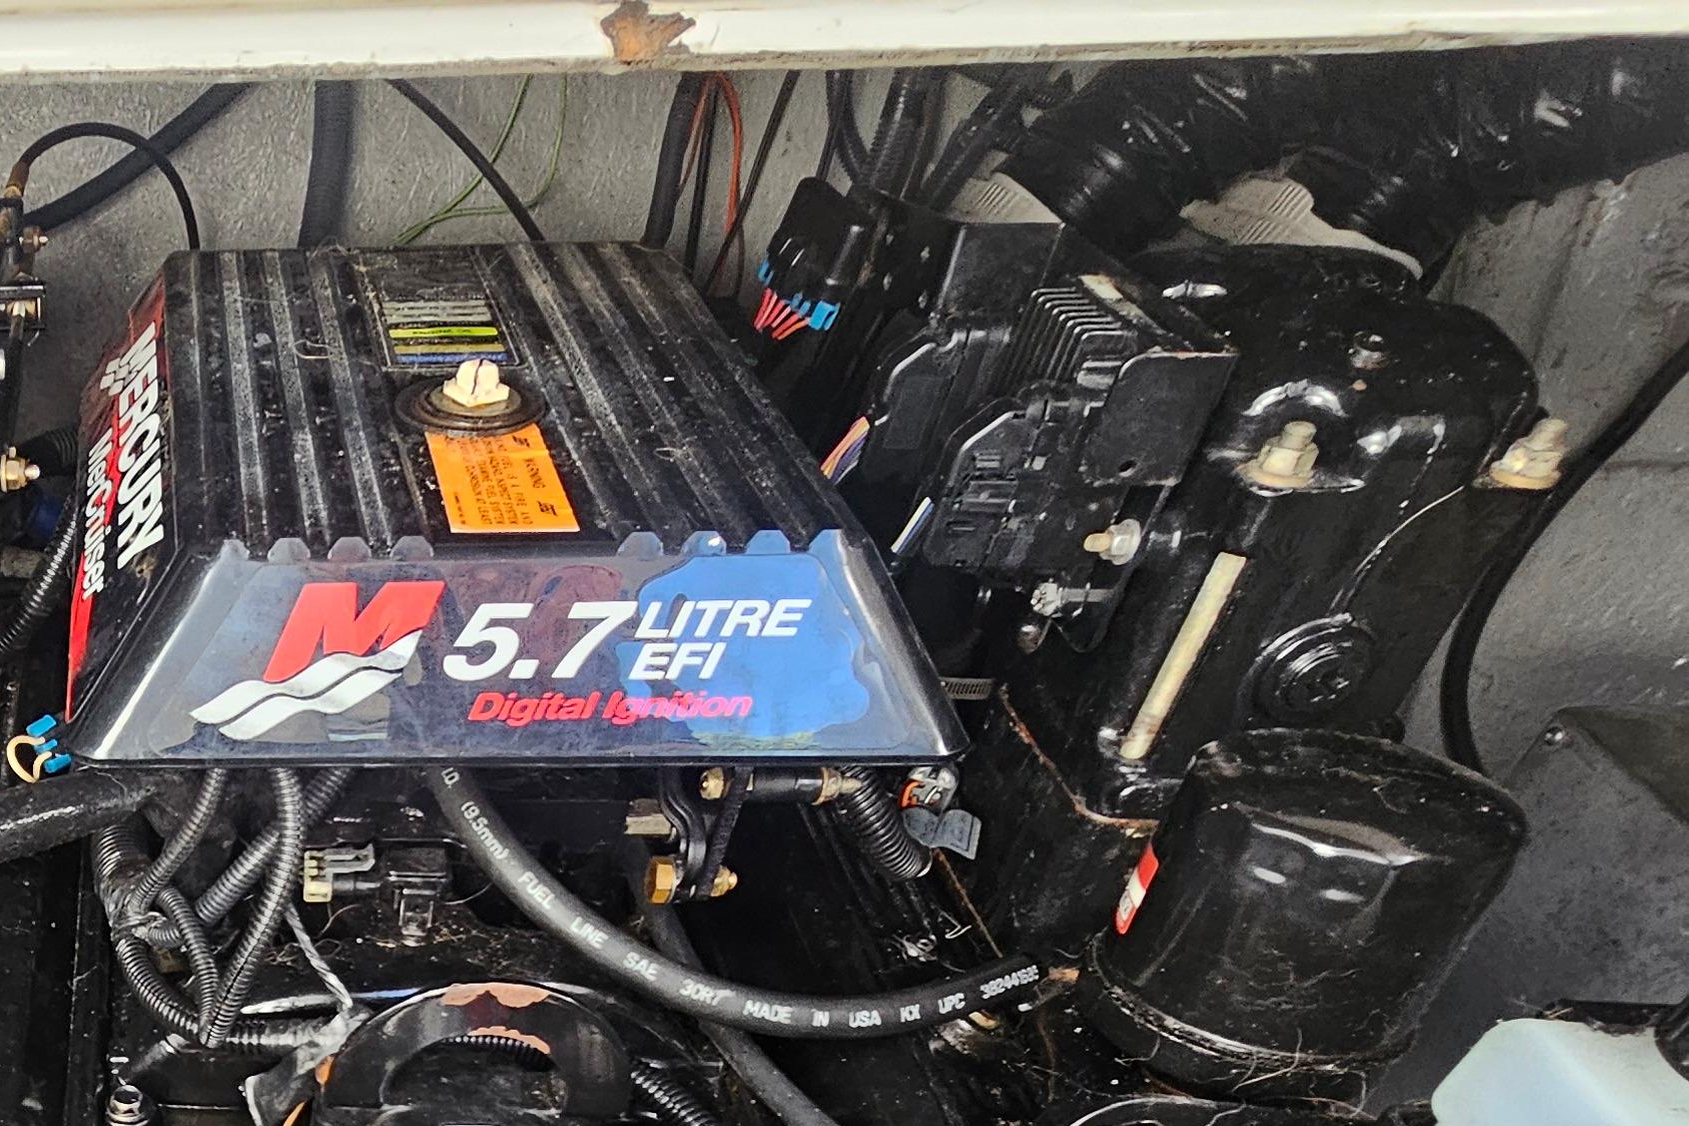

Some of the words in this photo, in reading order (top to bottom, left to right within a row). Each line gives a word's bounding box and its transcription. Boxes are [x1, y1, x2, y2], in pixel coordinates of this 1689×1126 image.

[117, 321, 164, 569] MERCURY
[82, 428, 112, 600] MerCruiser
[442, 600, 640, 681] 5.7
[633, 598, 813, 640] LITRE
[628, 641, 728, 681] EFI
[467, 691, 600, 727] Digital
[602, 691, 754, 726] Ignition
[516, 870, 558, 911] FUEL
[569, 915, 609, 951] LINE
[622, 950, 661, 983] SAE
[742, 999, 794, 1025] MADE
[812, 1008, 830, 1028] IN
[848, 1010, 882, 1028] USA
